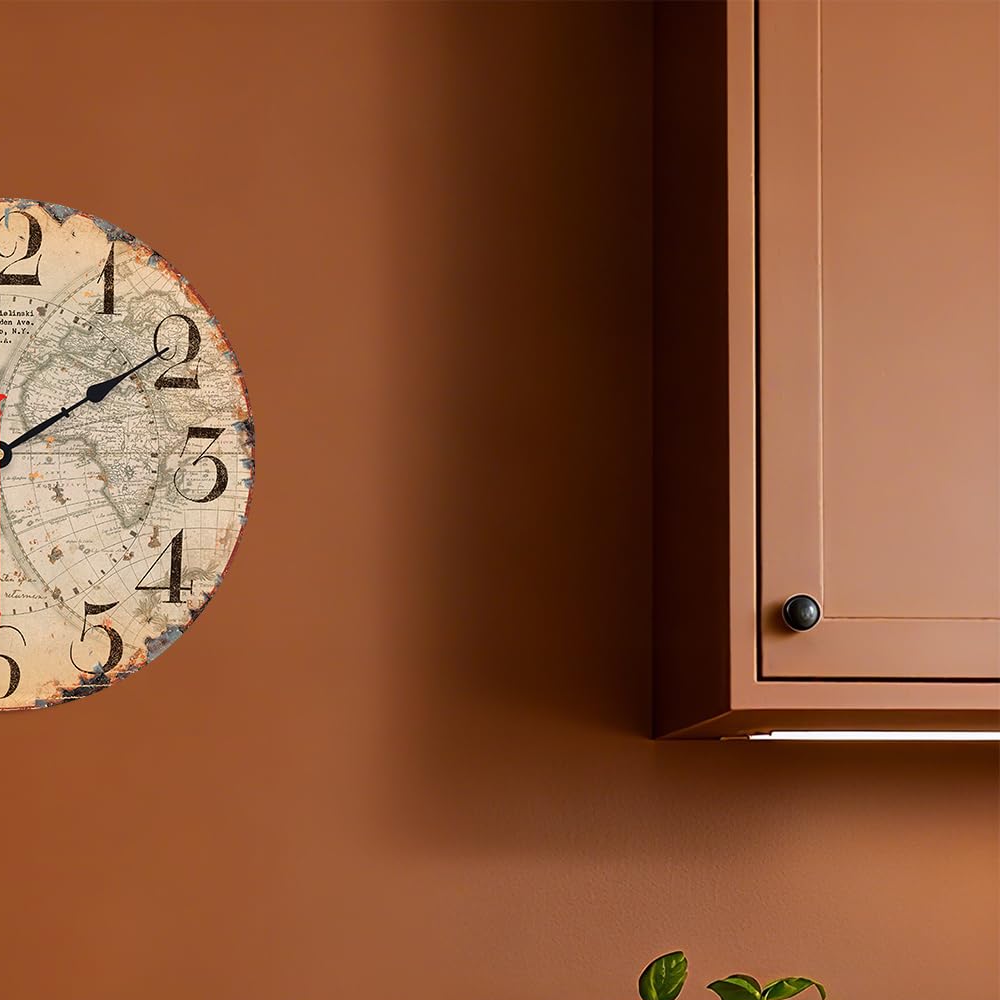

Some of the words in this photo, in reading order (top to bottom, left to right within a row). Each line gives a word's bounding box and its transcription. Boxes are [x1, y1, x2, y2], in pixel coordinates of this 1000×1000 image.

[95, 242, 117, 315] 1
[153, 314, 202, 390] 2
[174, 427, 229, 503] 3
[135, 528, 194, 603] 4
[70, 601, 124, 674] 5
